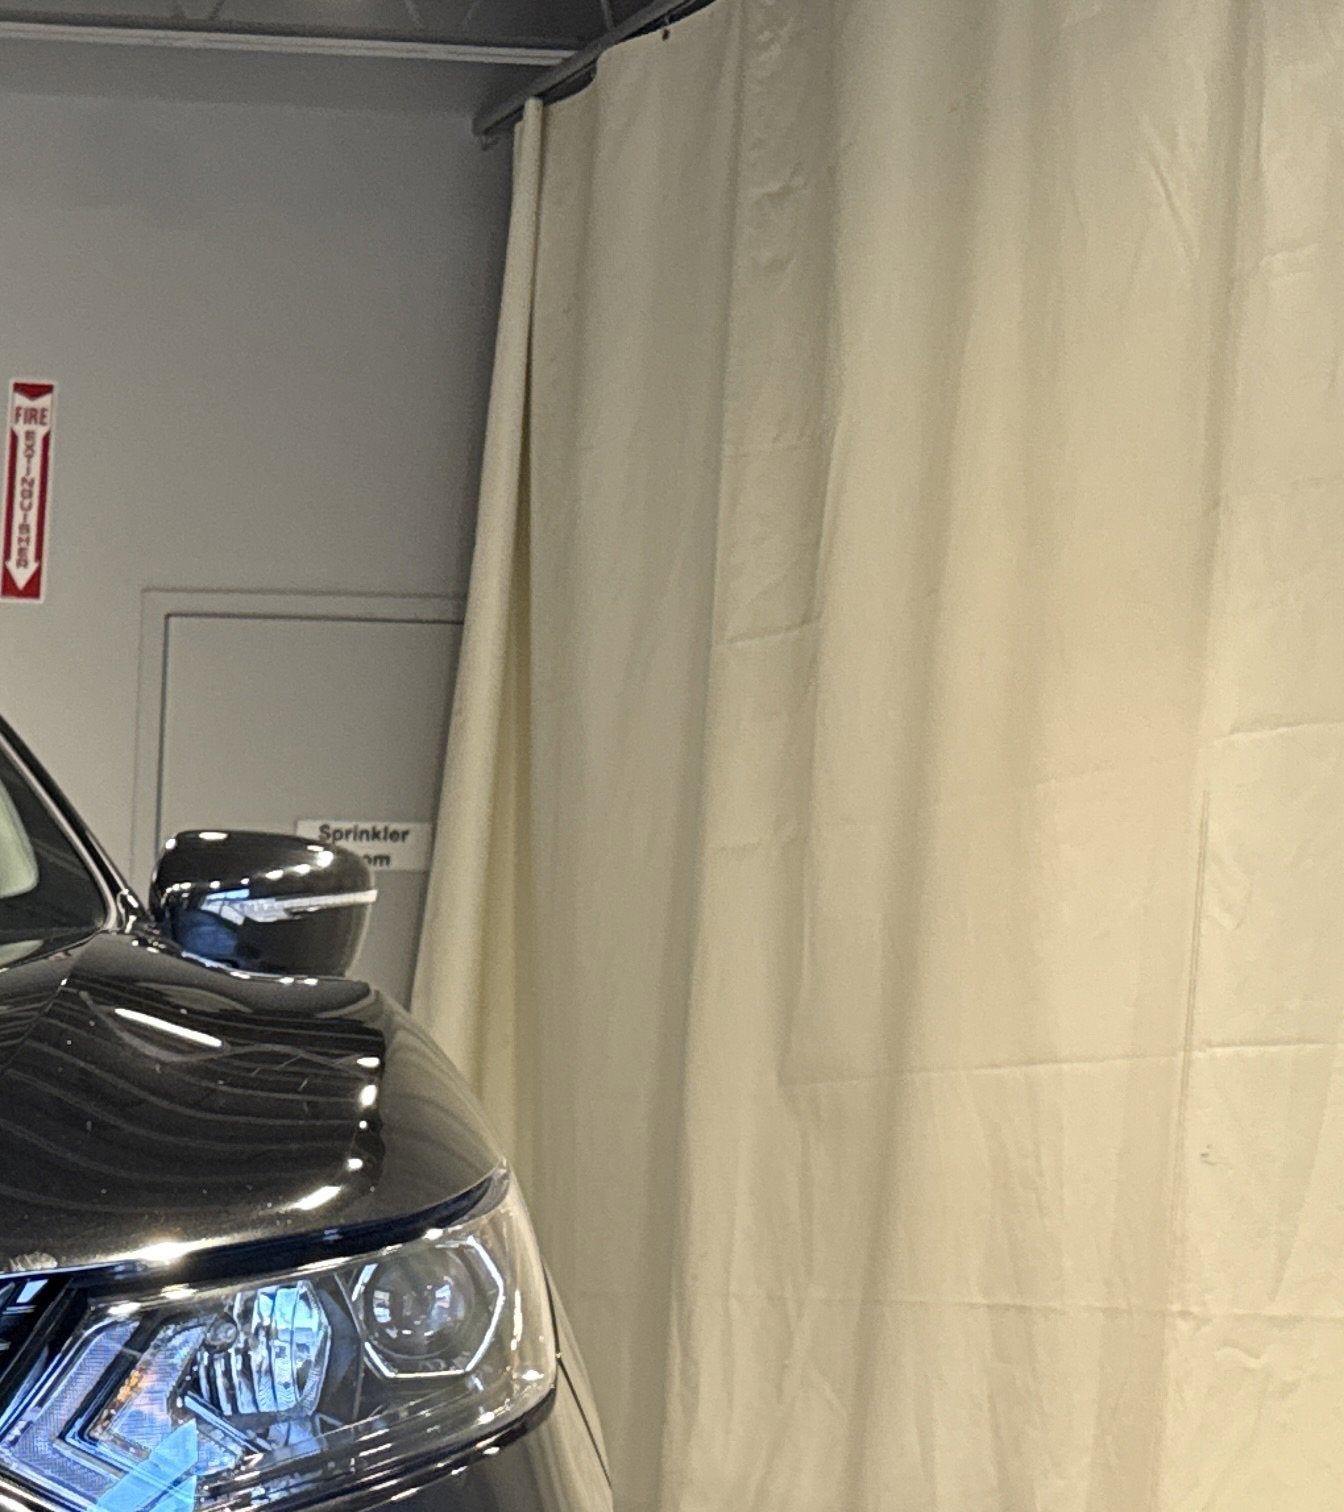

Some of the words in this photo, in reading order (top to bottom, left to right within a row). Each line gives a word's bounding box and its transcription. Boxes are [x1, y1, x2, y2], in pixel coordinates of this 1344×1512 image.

[14, 406, 48, 426] FIRE
[16, 429, 36, 569] EXTINGUISHER
[318, 824, 410, 844] Sprinkler
